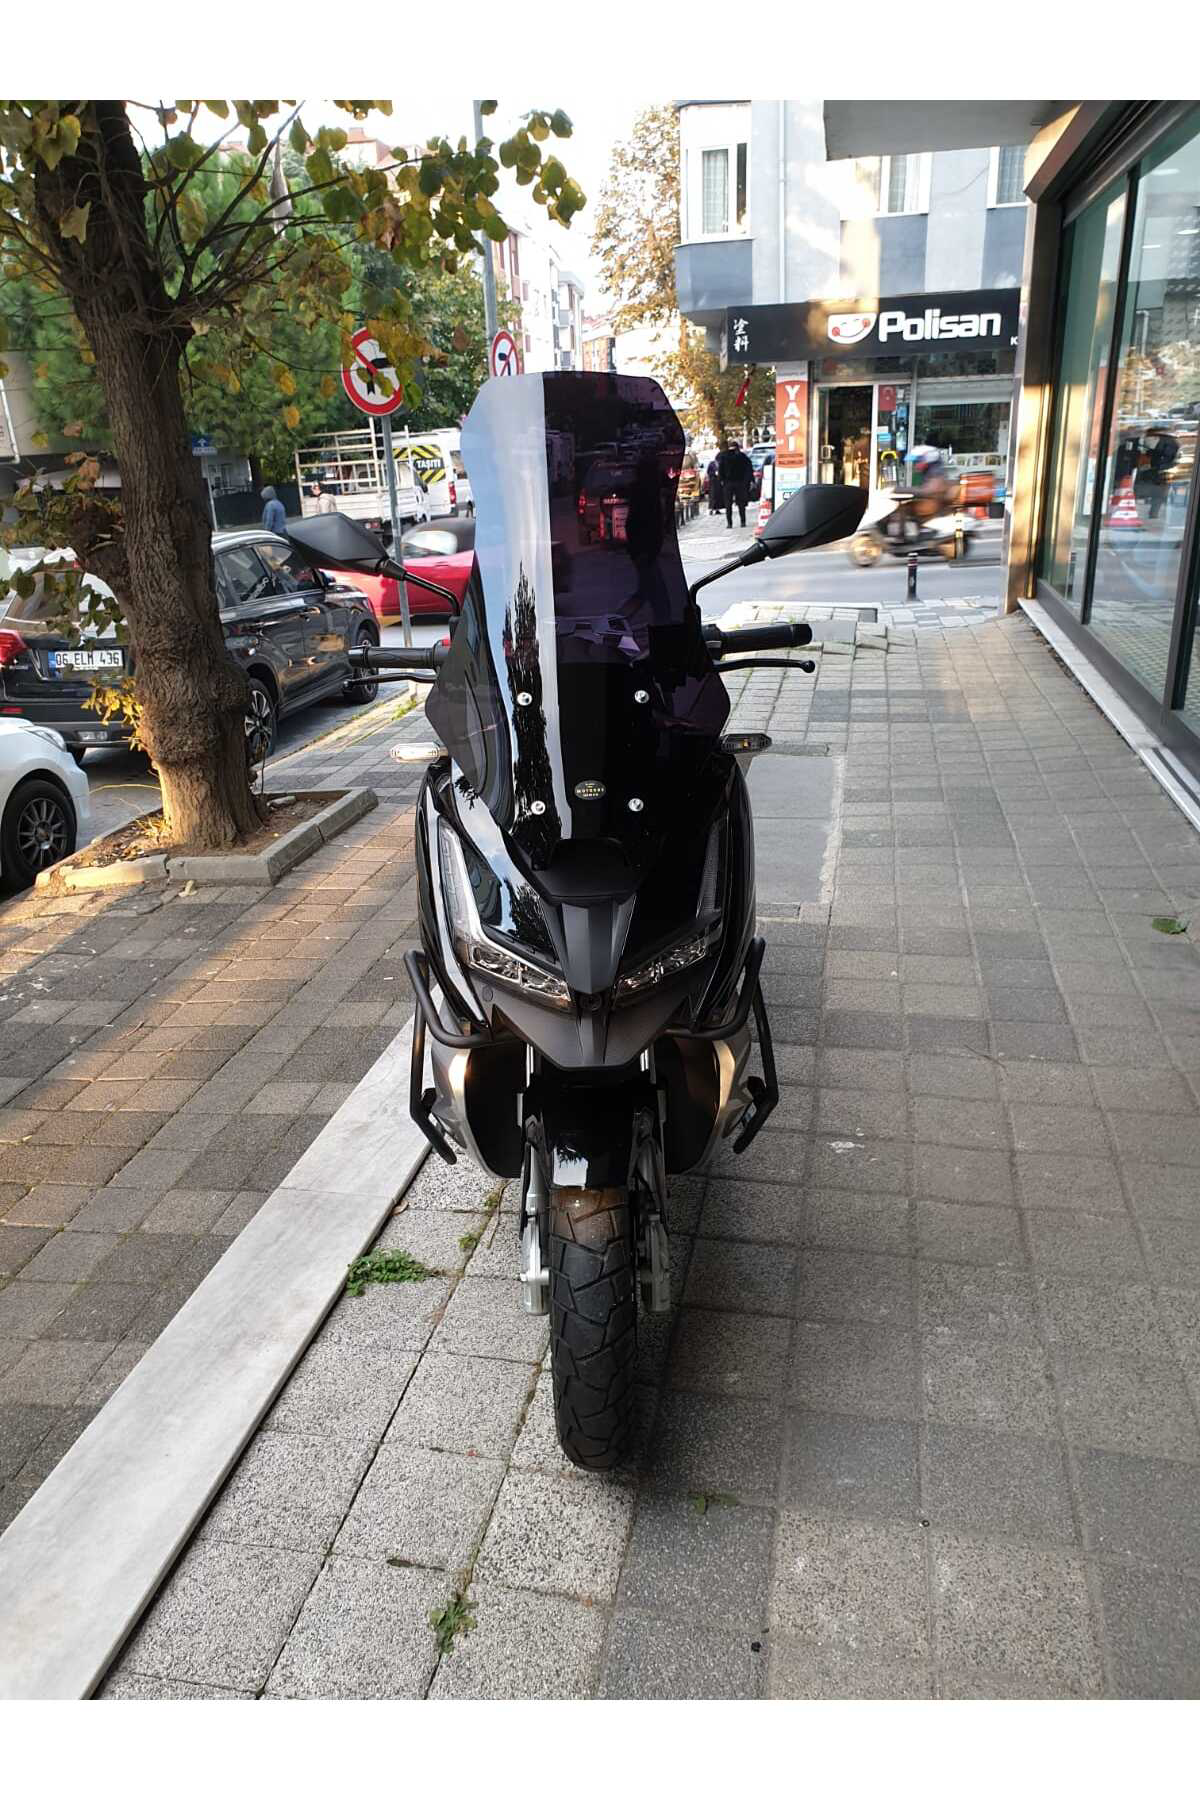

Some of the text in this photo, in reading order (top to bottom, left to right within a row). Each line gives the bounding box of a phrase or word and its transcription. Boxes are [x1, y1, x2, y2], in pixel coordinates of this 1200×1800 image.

[878, 308, 1002, 342] Polisan
[784, 384, 801, 452] YAPI
[55, 652, 69, 666] 06
[100, 651, 120, 665] 436
